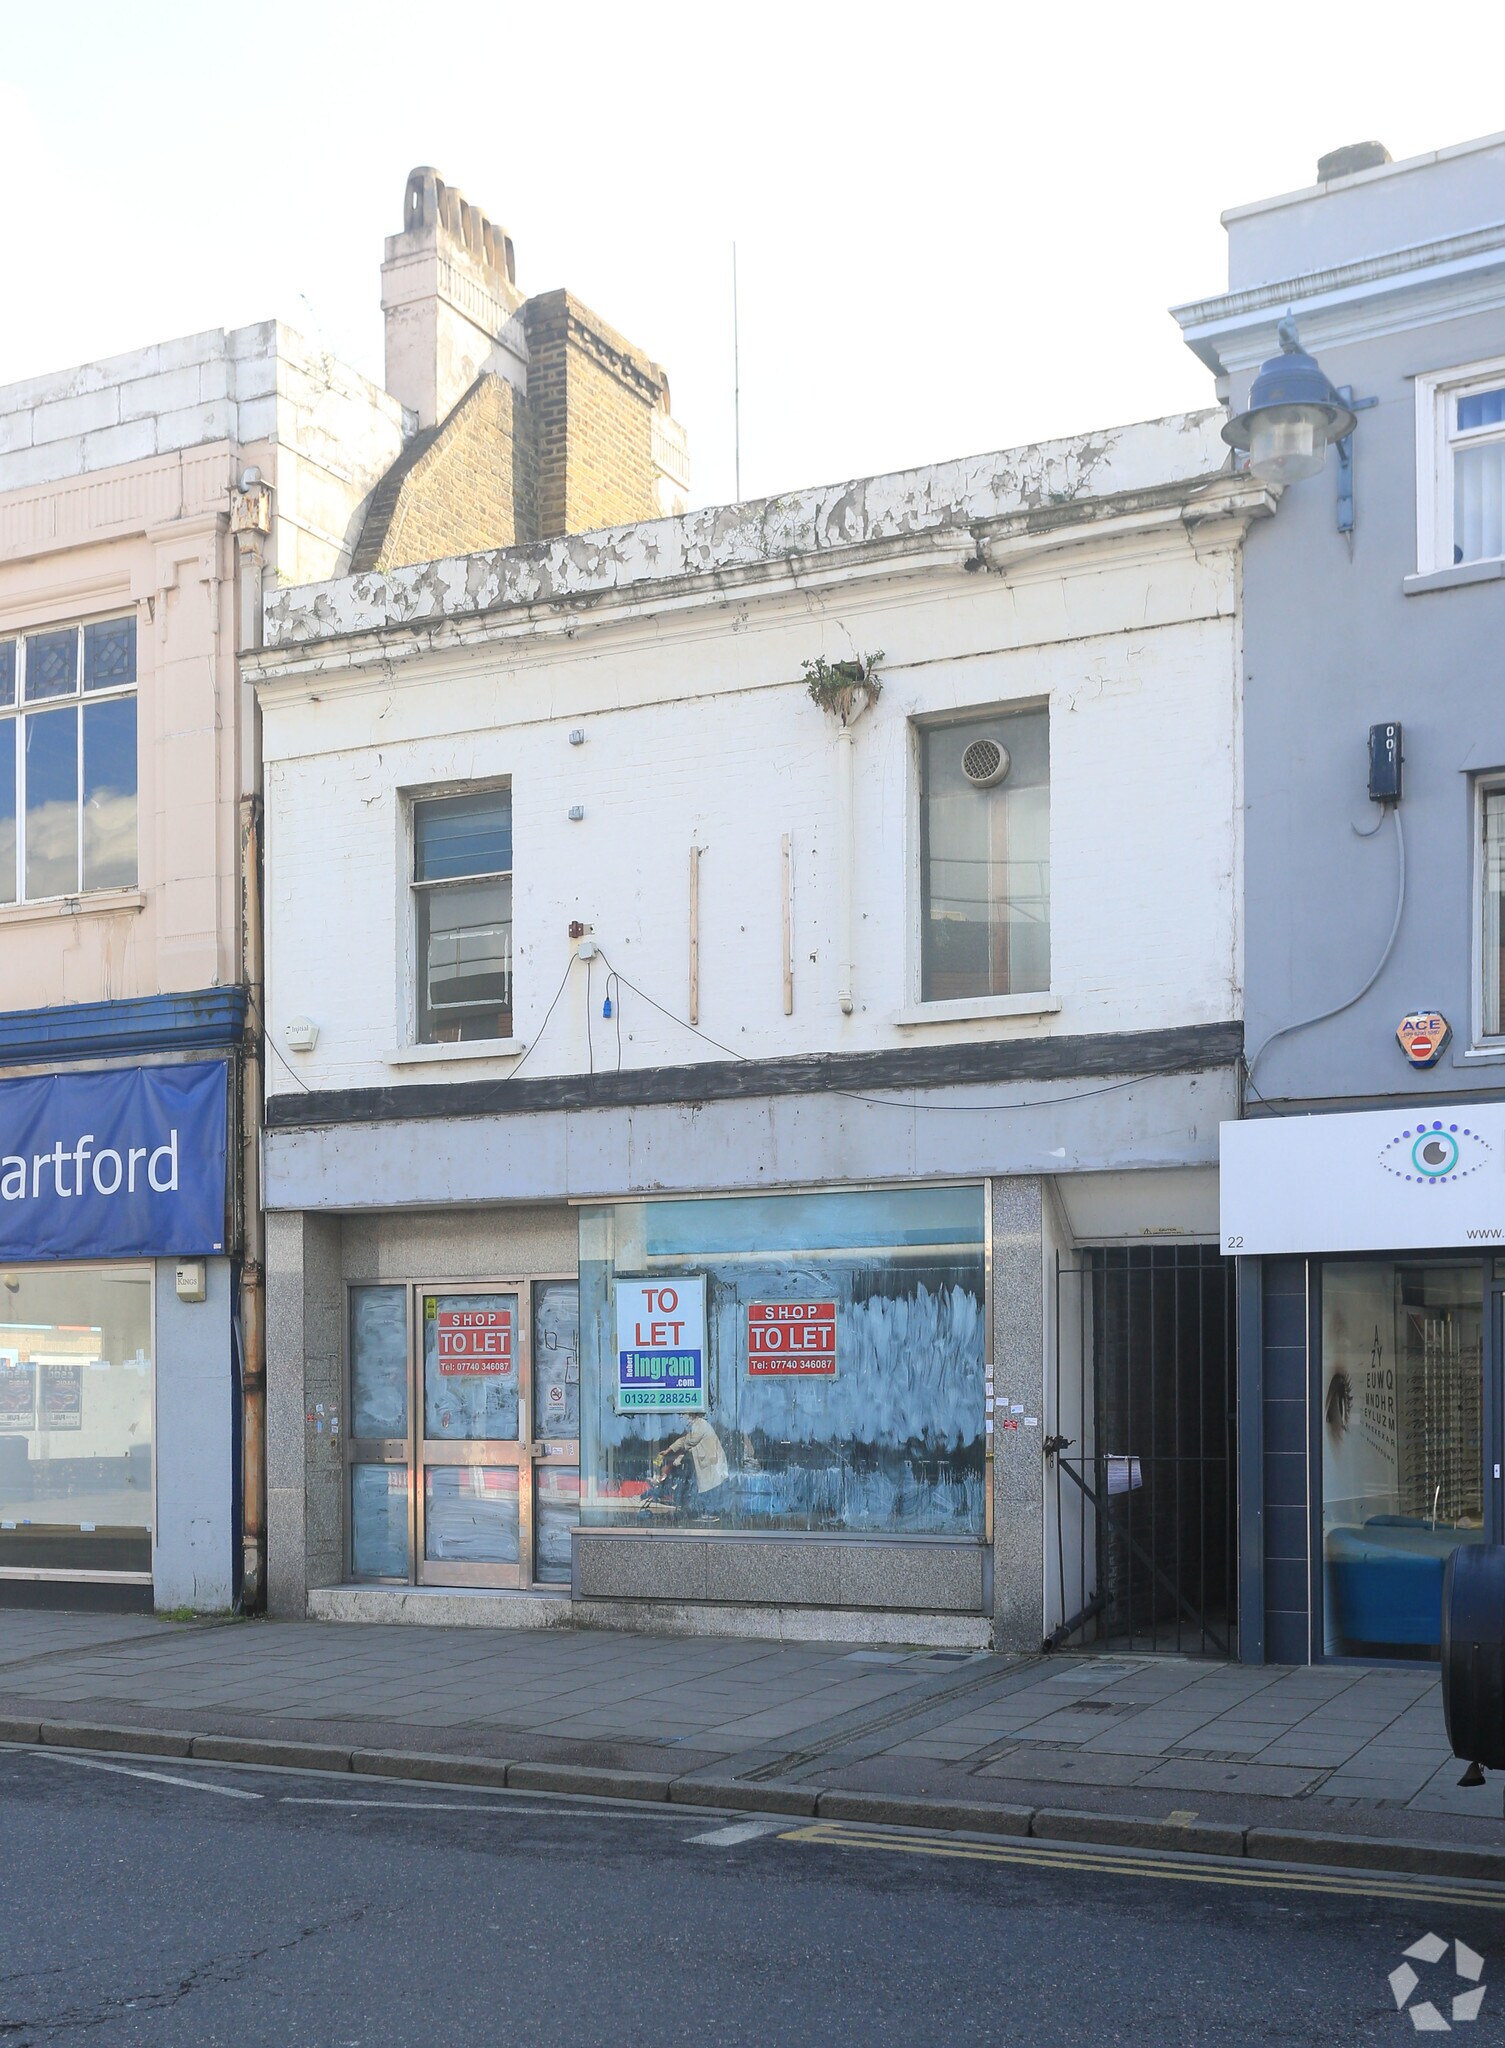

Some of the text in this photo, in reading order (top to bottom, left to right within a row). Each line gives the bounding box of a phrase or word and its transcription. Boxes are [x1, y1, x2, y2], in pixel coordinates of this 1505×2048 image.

[1402, 1019, 1441, 1031] ACE
[1, 1129, 178, 1201] artford
[1466, 1229, 1505, 1239] www.
[1228, 1236, 1244, 1248] 22
[641, 1288, 679, 1313] TO
[765, 1305, 817, 1319] SHOP
[452, 1314, 496, 1326] SHOP
[635, 1321, 685, 1347] LET
[751, 1326, 832, 1349] TO LET
[440, 1332, 509, 1353] TO LET
[441, 1362, 509, 1371] Tel: 07740 346087
[626, 1353, 634, 1378] Robert
[634, 1353, 695, 1380] Ingram
[751, 1359, 832, 1370] Tel: 07740 346087
[676, 1378, 695, 1387] .com
[624, 1392, 698, 1404] 01322 288254
